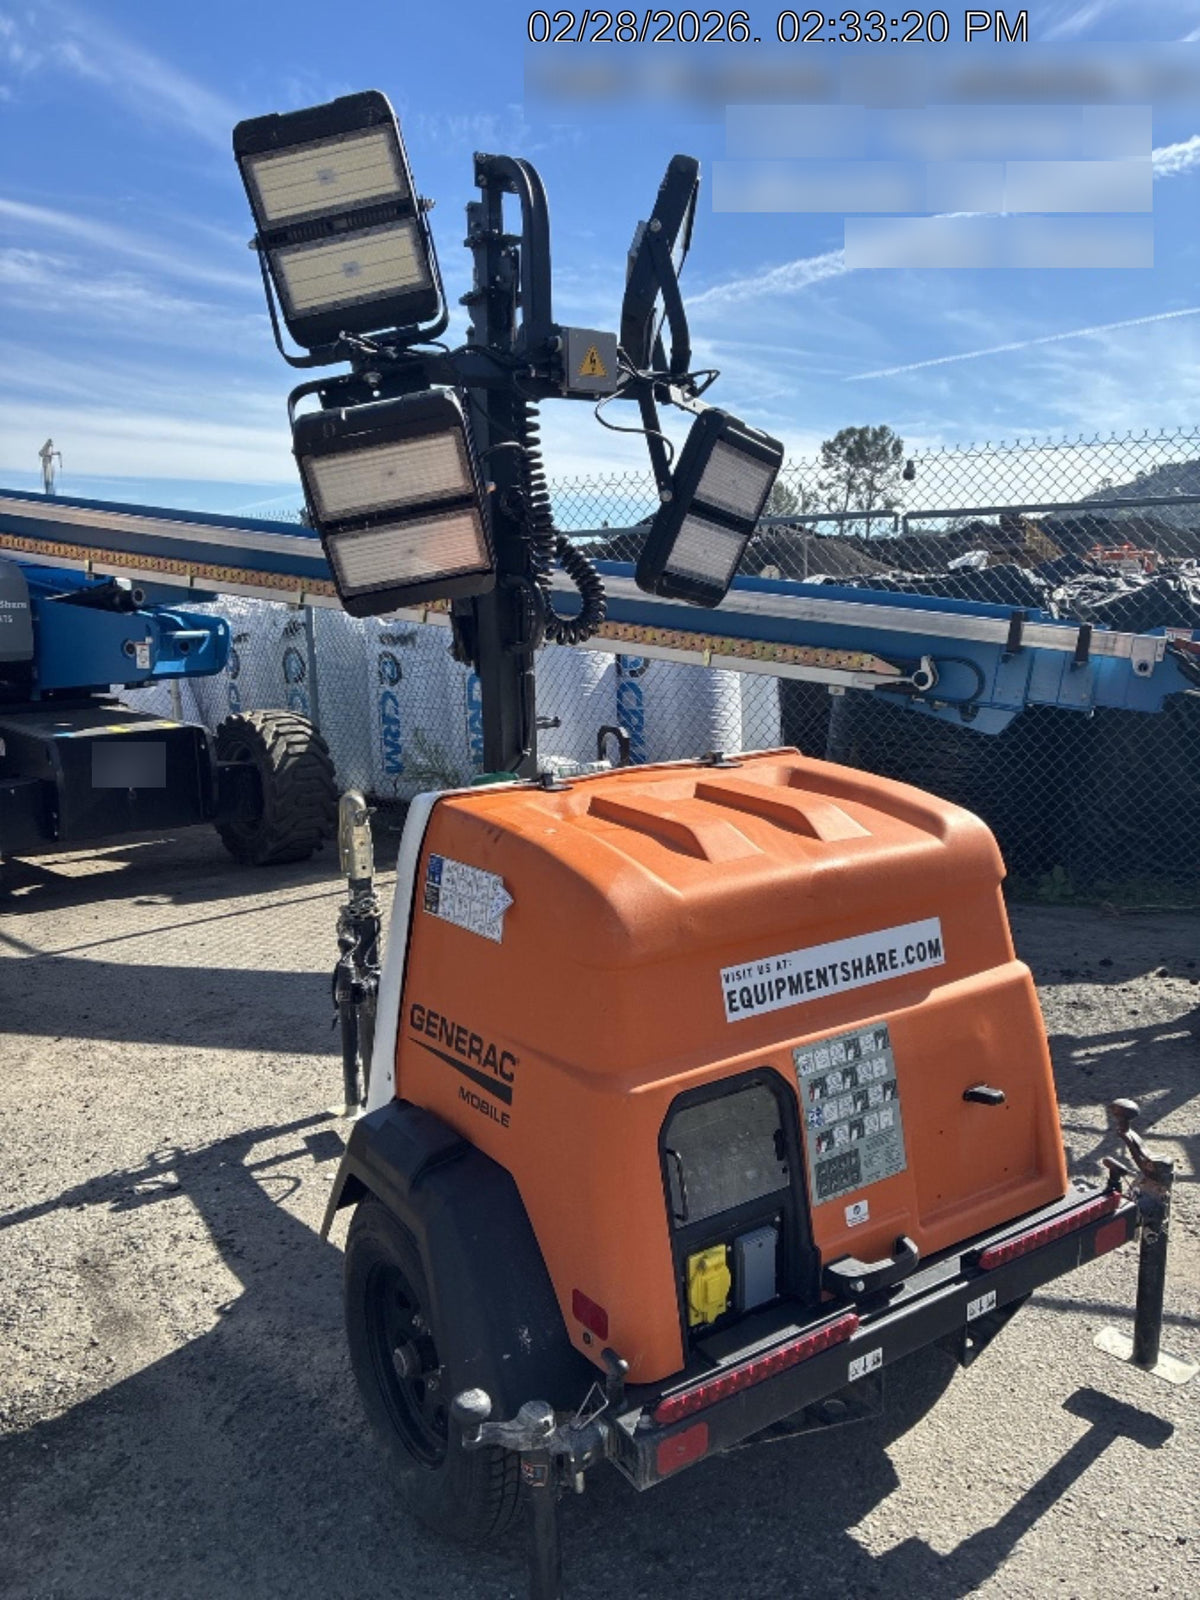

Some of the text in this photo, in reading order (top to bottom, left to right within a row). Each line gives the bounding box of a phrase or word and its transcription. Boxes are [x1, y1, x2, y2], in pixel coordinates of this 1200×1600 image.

[723, 959, 793, 984] VISIT US AT:
[726, 937, 943, 1014] EQUIPMENTSHARE.COM
[409, 1003, 517, 1083] GENERAC
[458, 1085, 512, 1129] MOBILE
